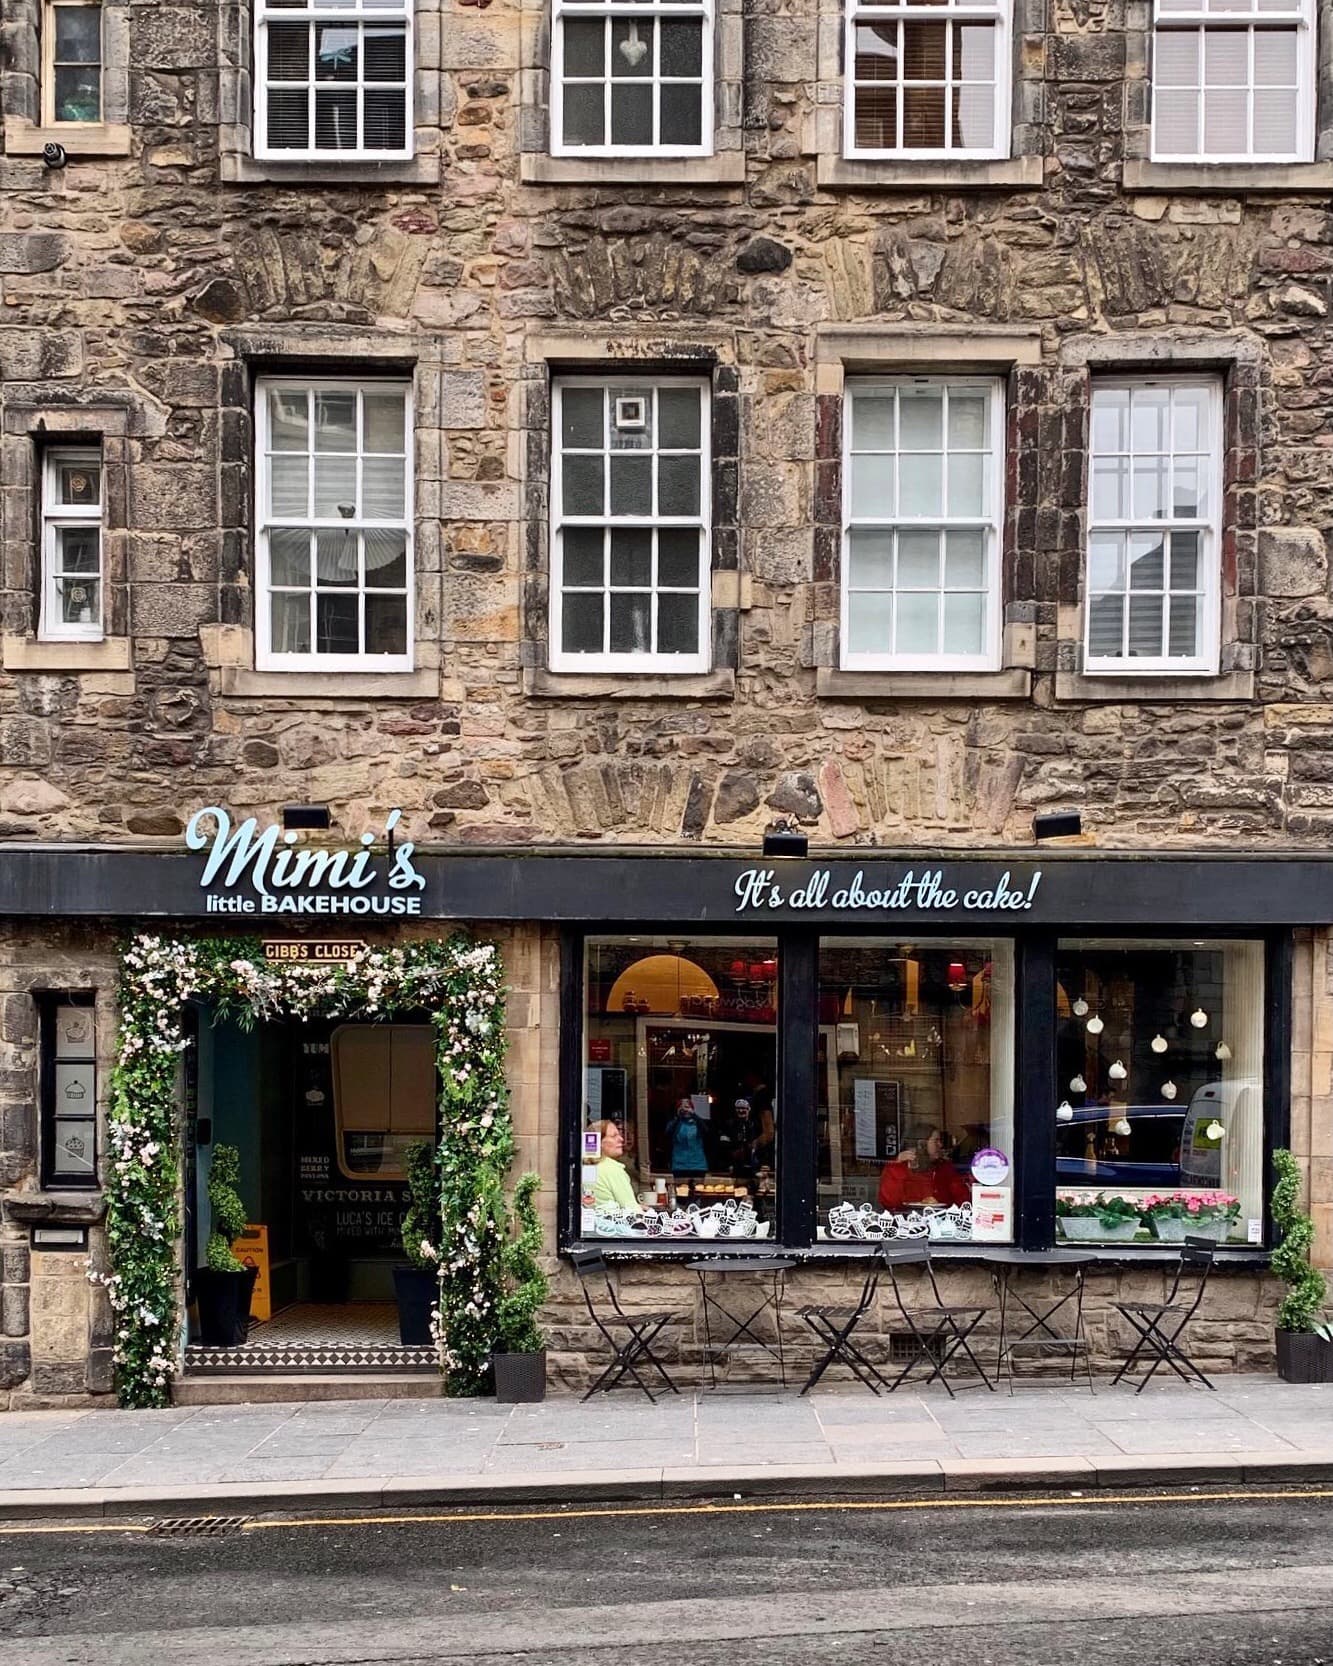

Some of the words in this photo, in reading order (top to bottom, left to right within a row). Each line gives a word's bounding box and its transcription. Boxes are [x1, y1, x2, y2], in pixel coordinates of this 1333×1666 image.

[185, 806, 426, 896] Mimi's
[734, 869, 785, 912] It's
[789, 870, 831, 909] all
[832, 870, 918, 909] about
[916, 870, 959, 909] the
[963, 871, 1042, 910] cake!
[206, 895, 255, 913] little
[261, 895, 421, 915] BAKEHOUSE
[265, 944, 308, 958] GIBB'S
[315, 945, 358, 958] CLOSE
[301, 1190, 396, 1202] VICTORIA
[336, 1210, 372, 1225] LUCA'S
[377, 1211, 394, 1225] ICE
